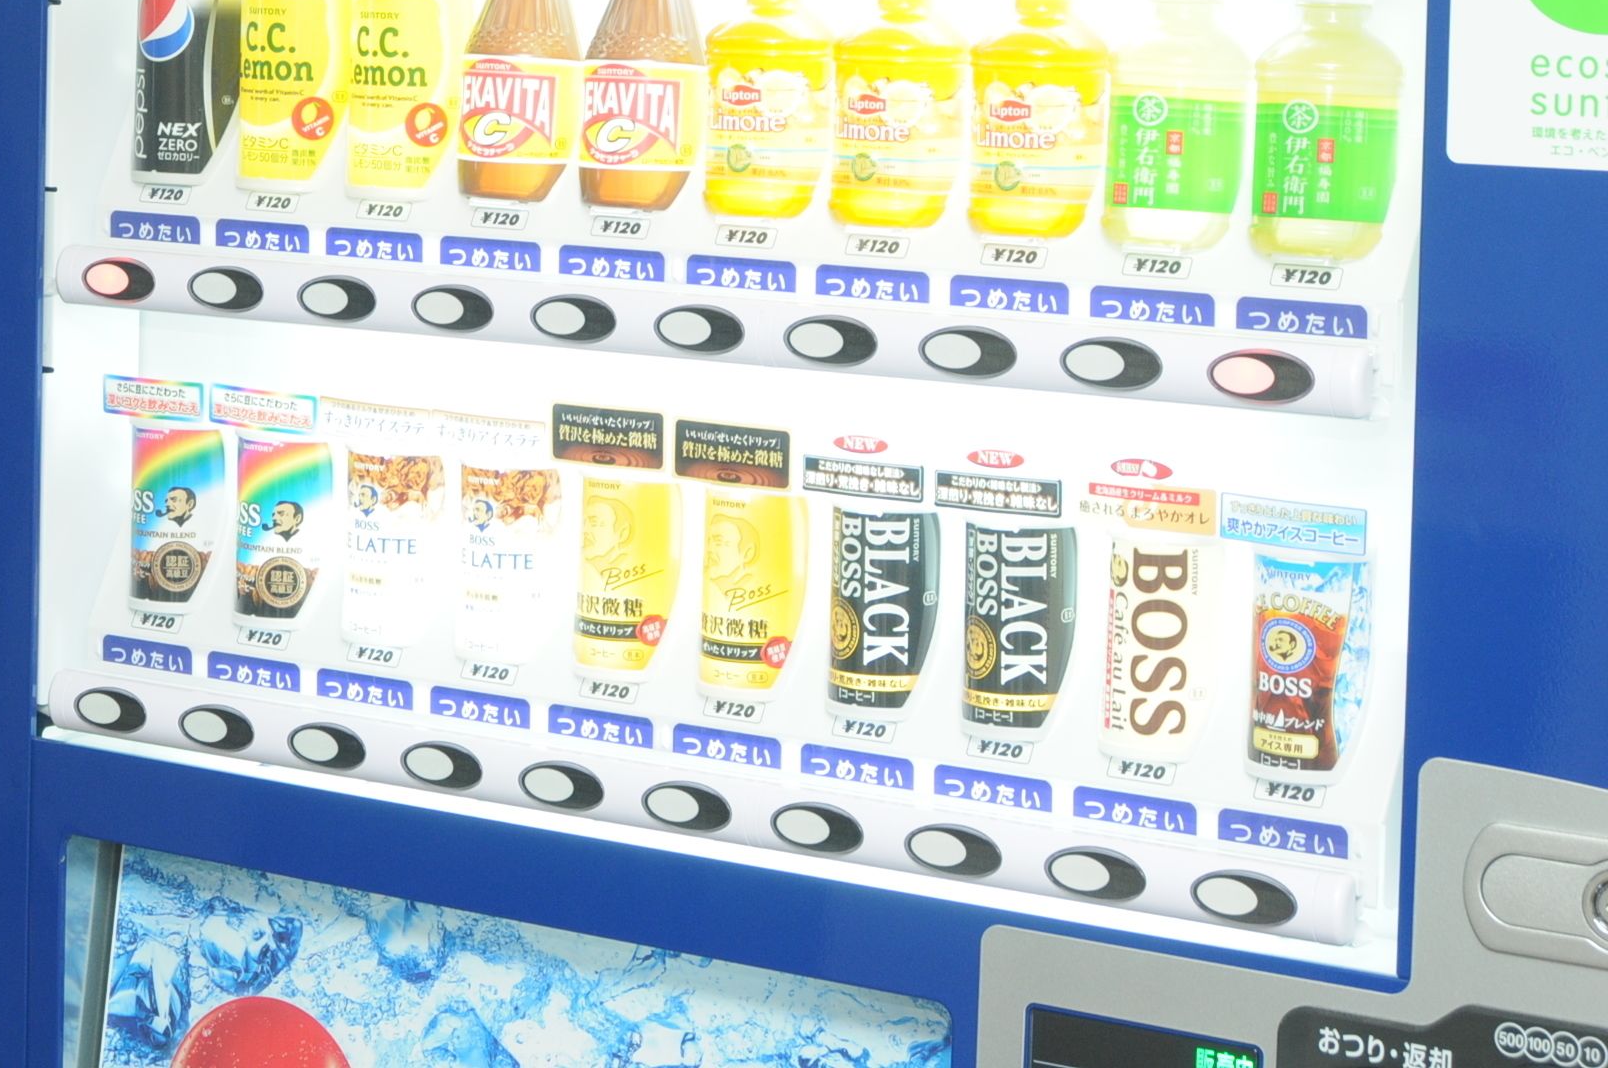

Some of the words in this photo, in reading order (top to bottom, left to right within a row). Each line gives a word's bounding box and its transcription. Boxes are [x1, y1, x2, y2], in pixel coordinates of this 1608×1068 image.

[246, 21, 296, 54] C.C.
[357, 26, 409, 58] C.C.
[476, 63, 511, 72] SUNTORY
[598, 68, 634, 76] SUNTORY
[723, 90, 760, 104] Lipton
[850, 99, 884, 113] Lipton
[1530, 92, 1608, 118] sun
[135, 68, 147, 160] pepsi
[710, 110, 787, 133] Limone
[991, 104, 1030, 120] Lipton
[157, 122, 203, 138] NEX
[475, 112, 510, 145] C
[596, 117, 635, 152] C
[836, 120, 910, 143] Limone
[977, 126, 1056, 150] Limone
[158, 138, 197, 152] ZERO
[157, 152, 200, 162] ゼロカロリー
[1134, 130, 1158, 206] 伊右衛門
[1282, 137, 1310, 214] 伊右衛門
[150, 188, 183, 200] ¥120
[483, 212, 519, 225] ¥120
[119, 221, 192, 243] つめたい
[856, 238, 899, 253] ¥120
[568, 256, 654, 281] つめたい
[1282, 270, 1331, 284] ¥120
[1101, 299, 1202, 325] つめたい
[116, 382, 186, 398] さらに豆にこだわった
[224, 392, 298, 410] さらに豆にこだわった
[106, 394, 199, 414] 深いコクと飲みごたえ
[213, 403, 313, 428] 深いコクと飲みごたえ
[324, 410, 425, 435] すっきりアイスラテ
[437, 421, 541, 448] すっきりアイスラテ
[558, 424, 658, 450] 贅沢を極めた微糖
[842, 436, 878, 452] NEW
[682, 441, 784, 468] 贅沢を極めた微糖
[977, 451, 1013, 466] NEW
[354, 518, 380, 531] BOSS
[1226, 516, 1359, 546] 爽やかアイスコーヒー
[356, 537, 417, 554] LATTE
[470, 534, 495, 548] BOSS
[472, 552, 534, 570] LATTE
[840, 517, 862, 598] BOSS
[976, 532, 998, 617] BOSS
[862, 517, 910, 666] BLACK
[1000, 530, 1048, 687] BLACK
[1270, 595, 1342, 630] COFFEE
[1128, 547, 1189, 736] BOSS
[358, 647, 393, 662] ¥120
[590, 648, 614, 658] コーヒー
[713, 669, 740, 681] コーヒー
[324, 679, 403, 706] つめたい
[1258, 676, 1312, 698] BOSS
[716, 701, 755, 717] ¥120
[1284, 716, 1324, 730] ブレンド
[1260, 739, 1304, 755] アイス専用
[811, 756, 902, 785] つめたい
[1119, 762, 1165, 779] ¥120
[1230, 823, 1334, 853] つめたい
[1318, 1027, 1452, 1068] おつり・返却
[1500, 1030, 1524, 1047] 500
[1528, 1036, 1551, 1052] 100
[1556, 1041, 1576, 1058] 50
[1584, 1046, 1601, 1063] 10
